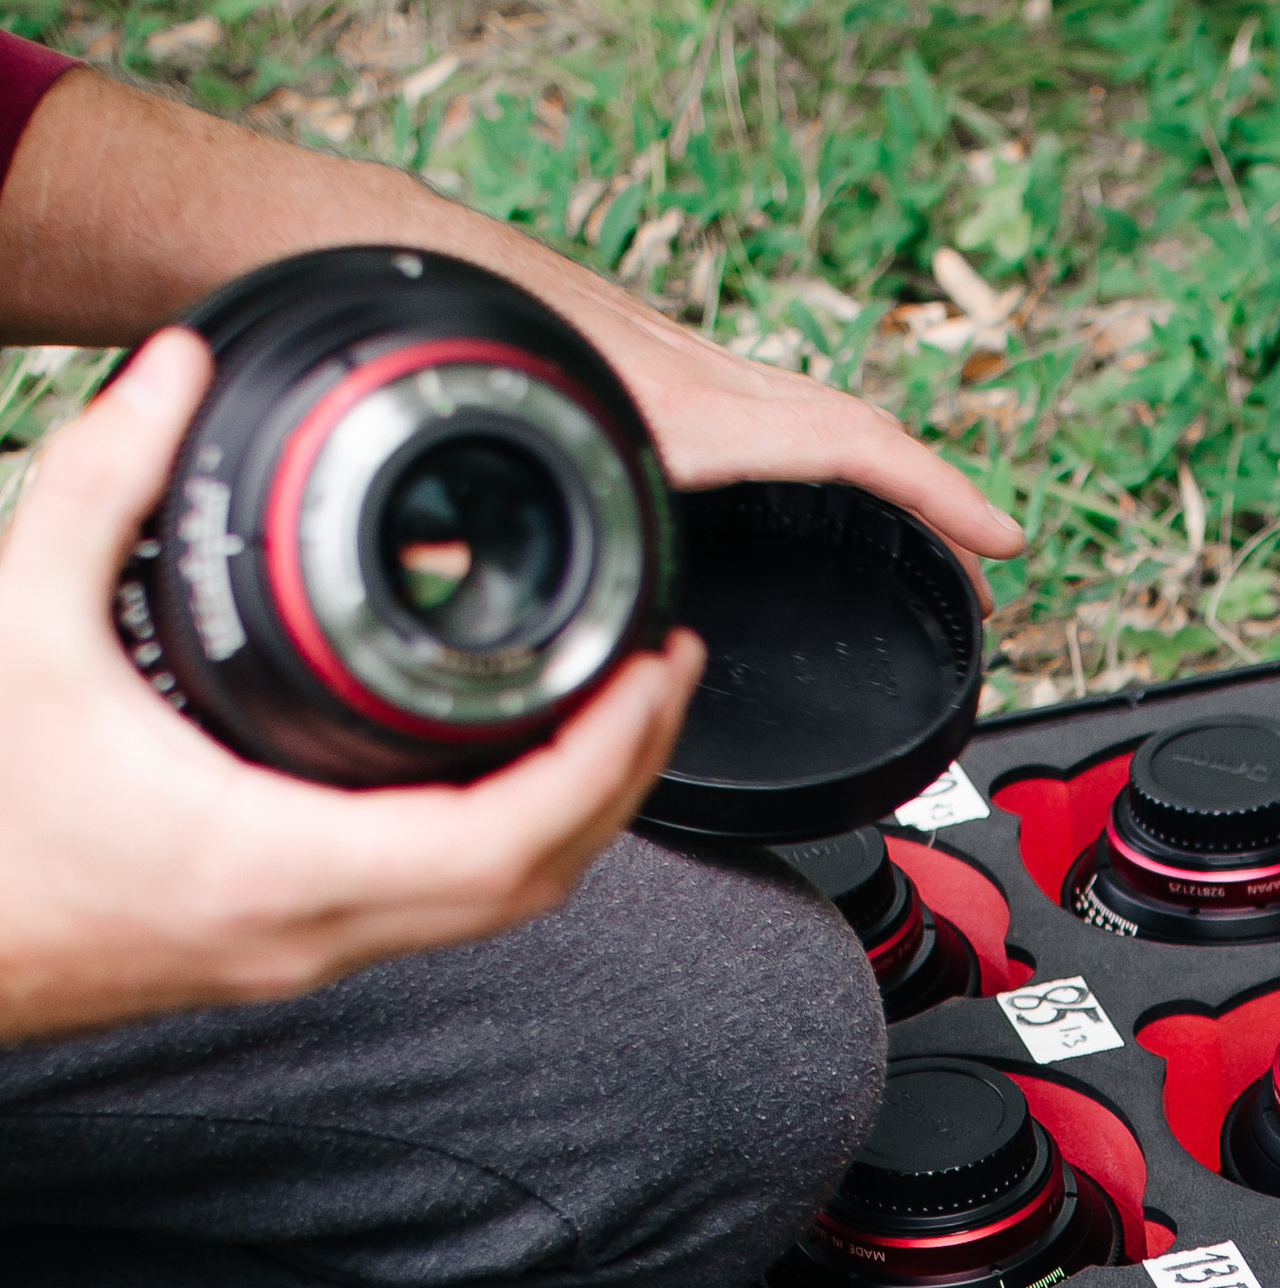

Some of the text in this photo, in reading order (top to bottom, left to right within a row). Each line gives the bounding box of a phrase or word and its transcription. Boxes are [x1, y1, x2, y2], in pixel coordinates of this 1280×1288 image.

[1006, 985, 1104, 1027] 85
[1058, 1025, 1088, 1049] 1.3
[832, 1235, 886, 1263] MADE IN
